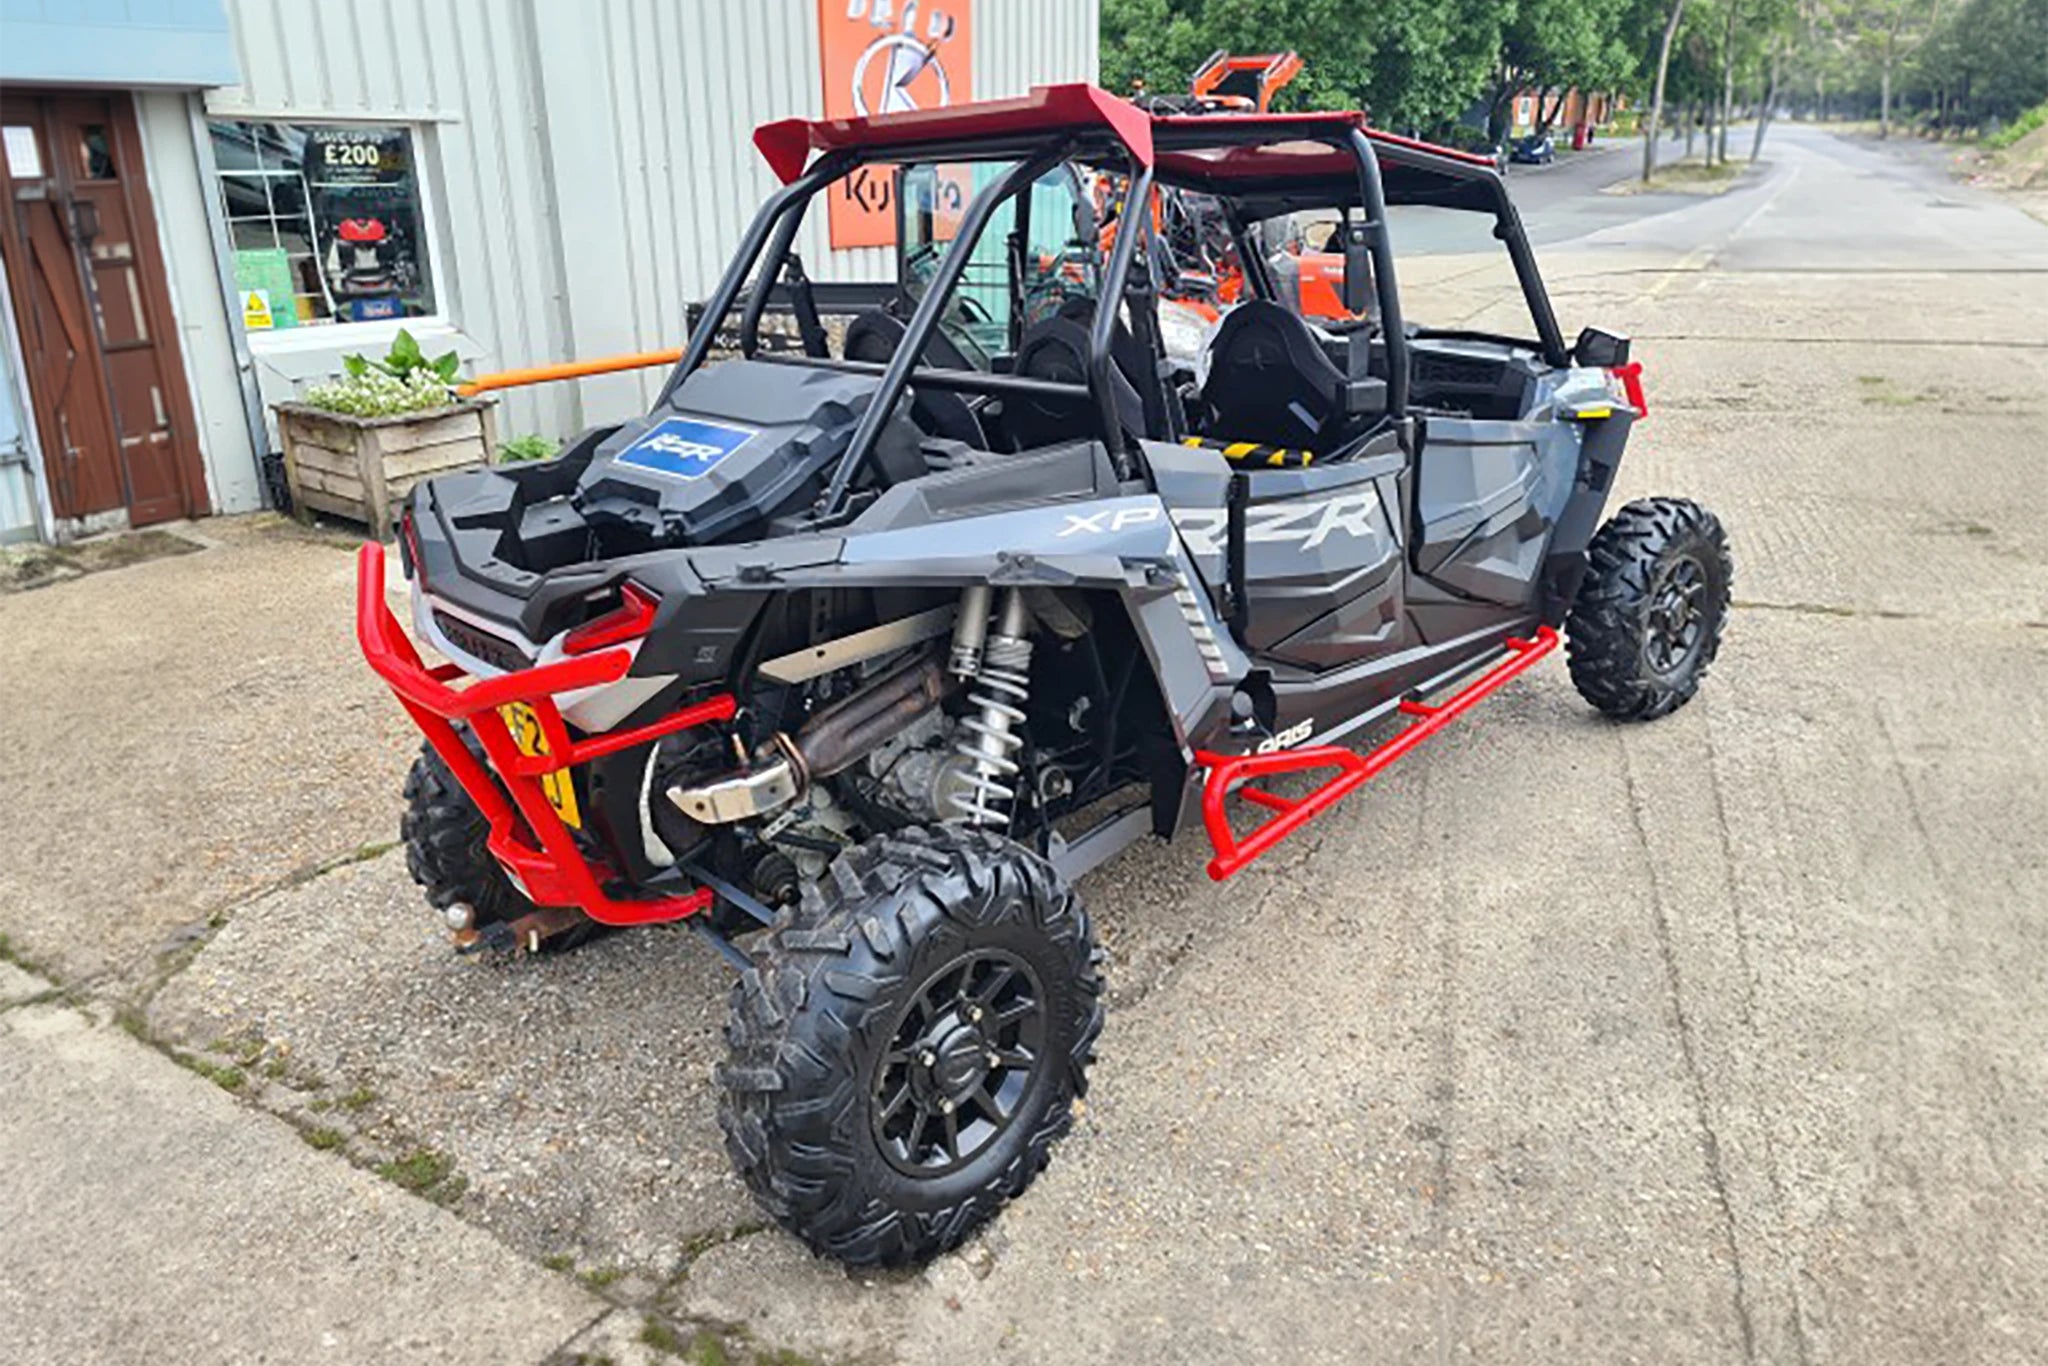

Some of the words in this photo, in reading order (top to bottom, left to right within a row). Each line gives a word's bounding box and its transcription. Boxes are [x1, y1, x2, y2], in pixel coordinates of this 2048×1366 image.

[324, 144, 379, 165] £200
[845, 168, 961, 213] Kuta
[1057, 508, 1159, 537] XP
[1166, 492, 1378, 555] RZR
